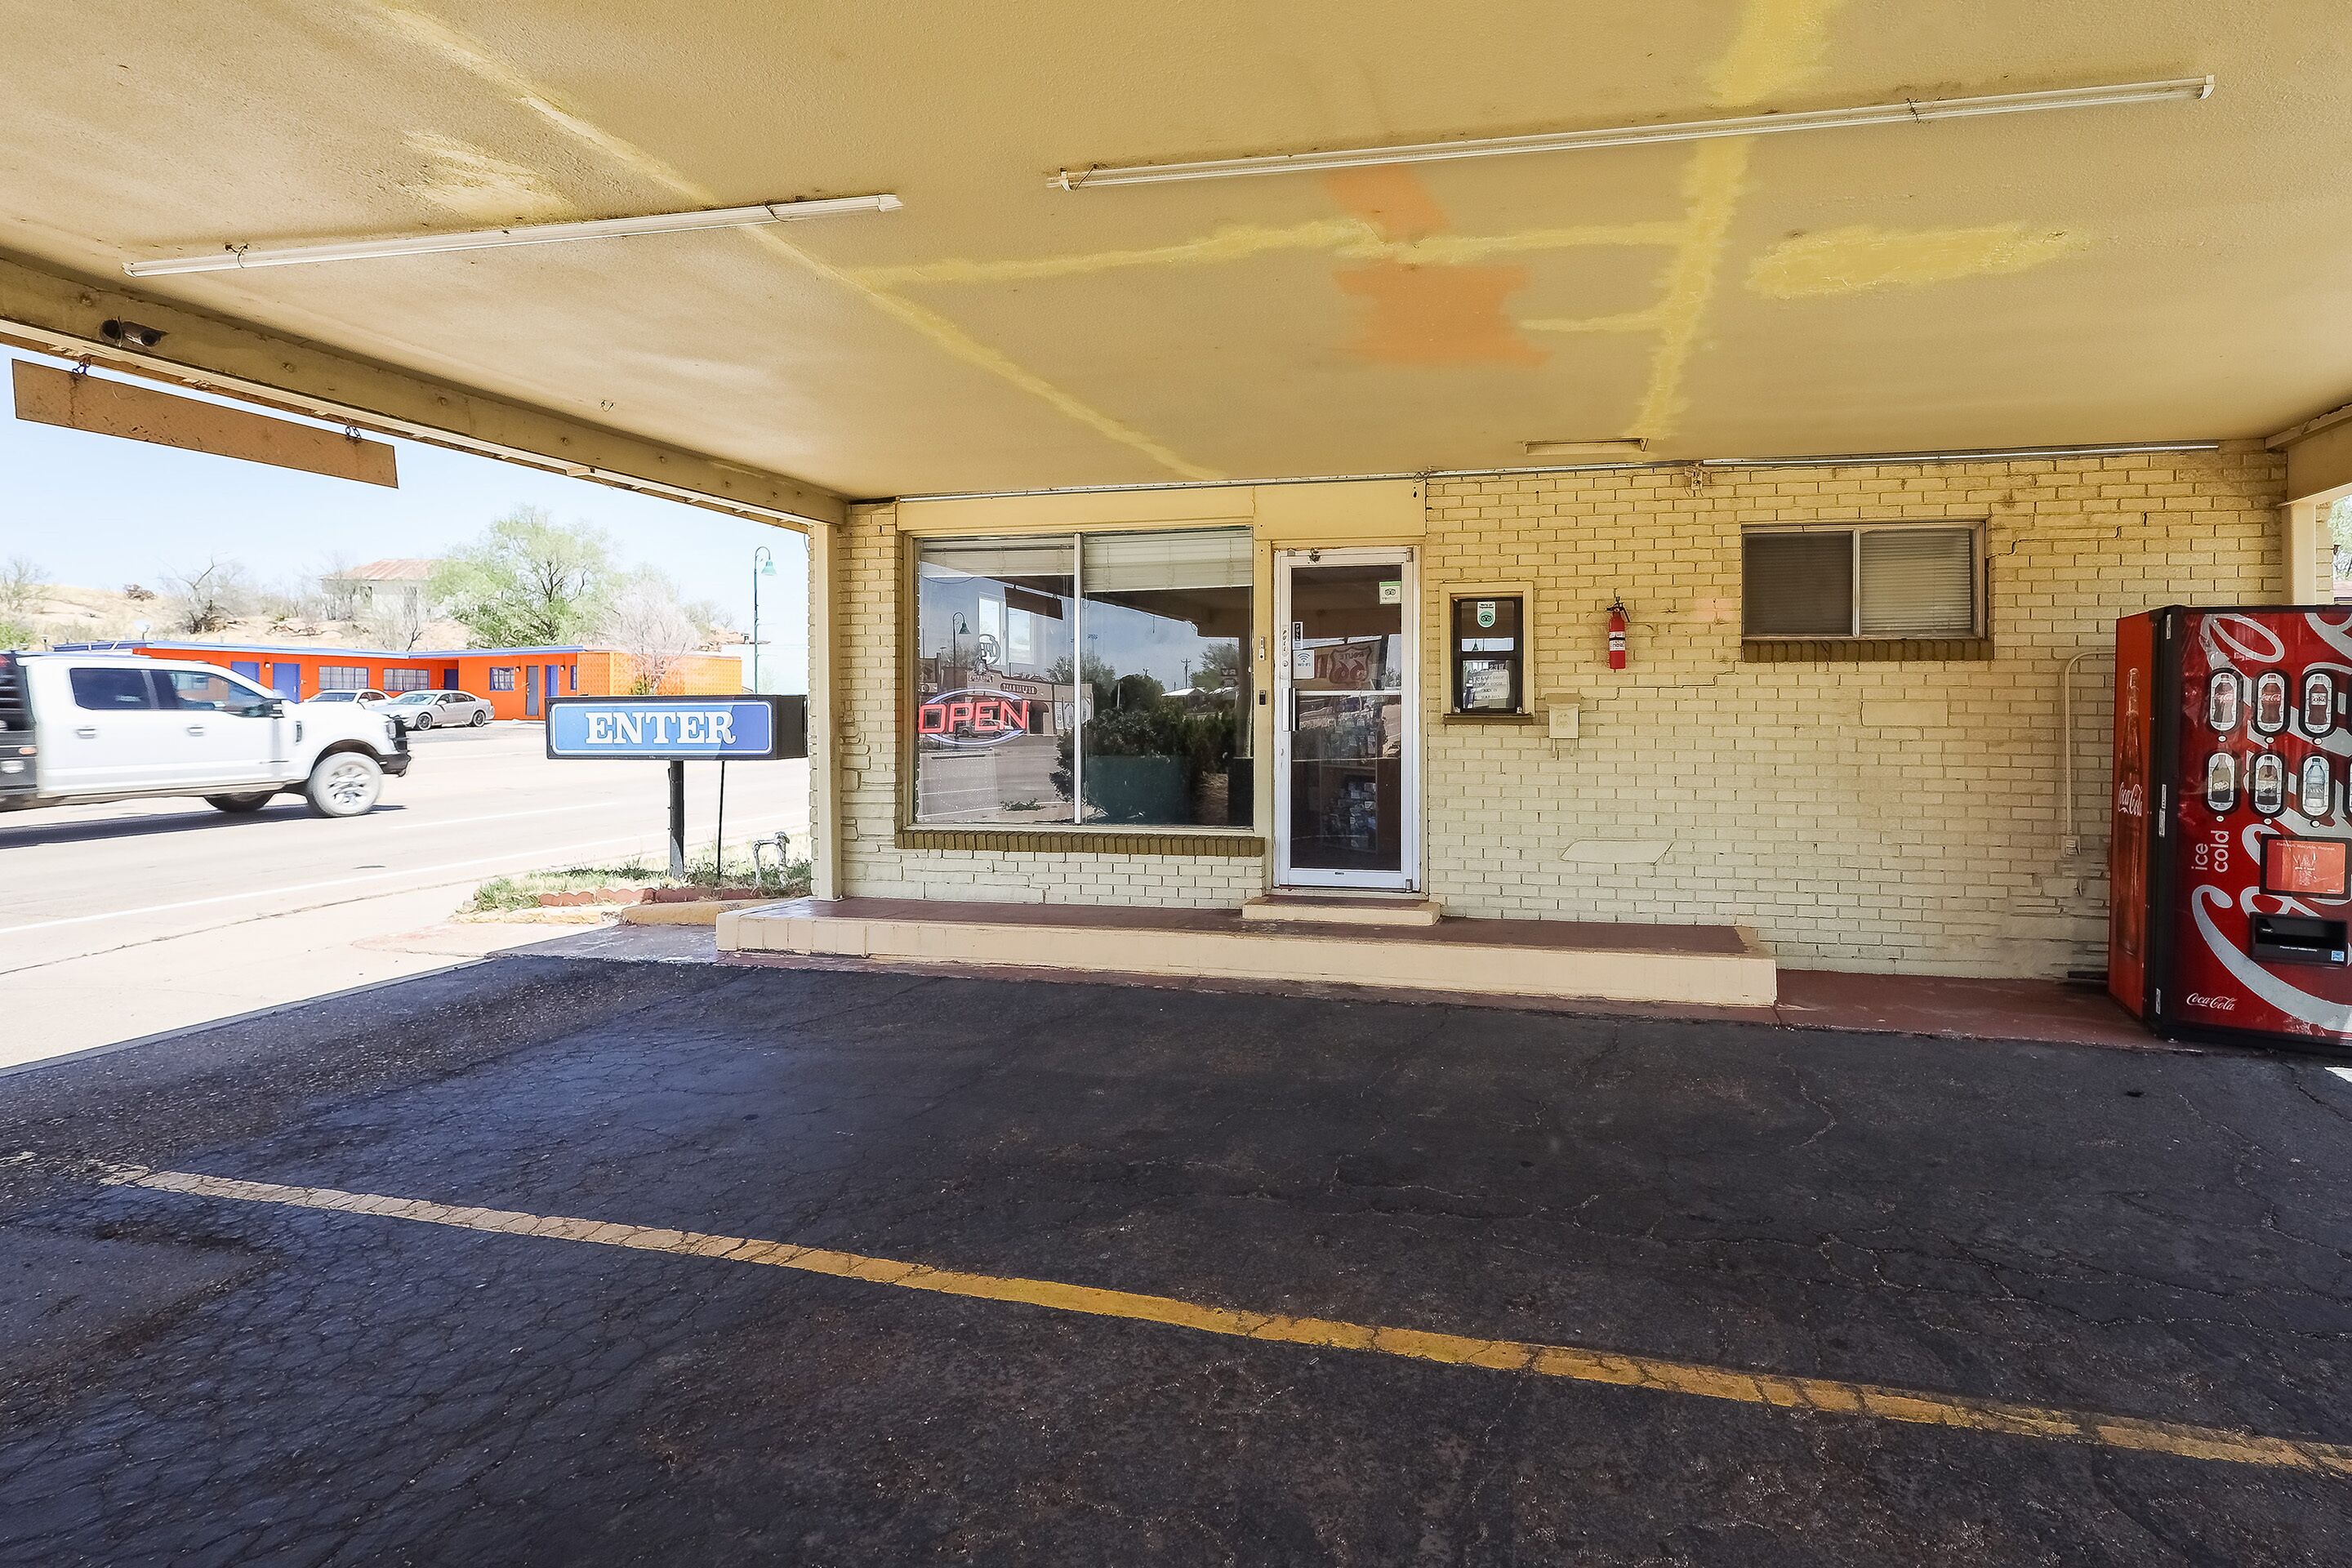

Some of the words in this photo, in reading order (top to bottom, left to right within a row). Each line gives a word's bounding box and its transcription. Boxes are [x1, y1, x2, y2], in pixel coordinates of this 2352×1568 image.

[585, 711, 737, 745] ENTER
[918, 700, 1029, 733] OPEN
[2191, 843, 2209, 871] ice
[2210, 830, 2230, 873] cold
[2186, 992, 2238, 1011] Coca-Cola
